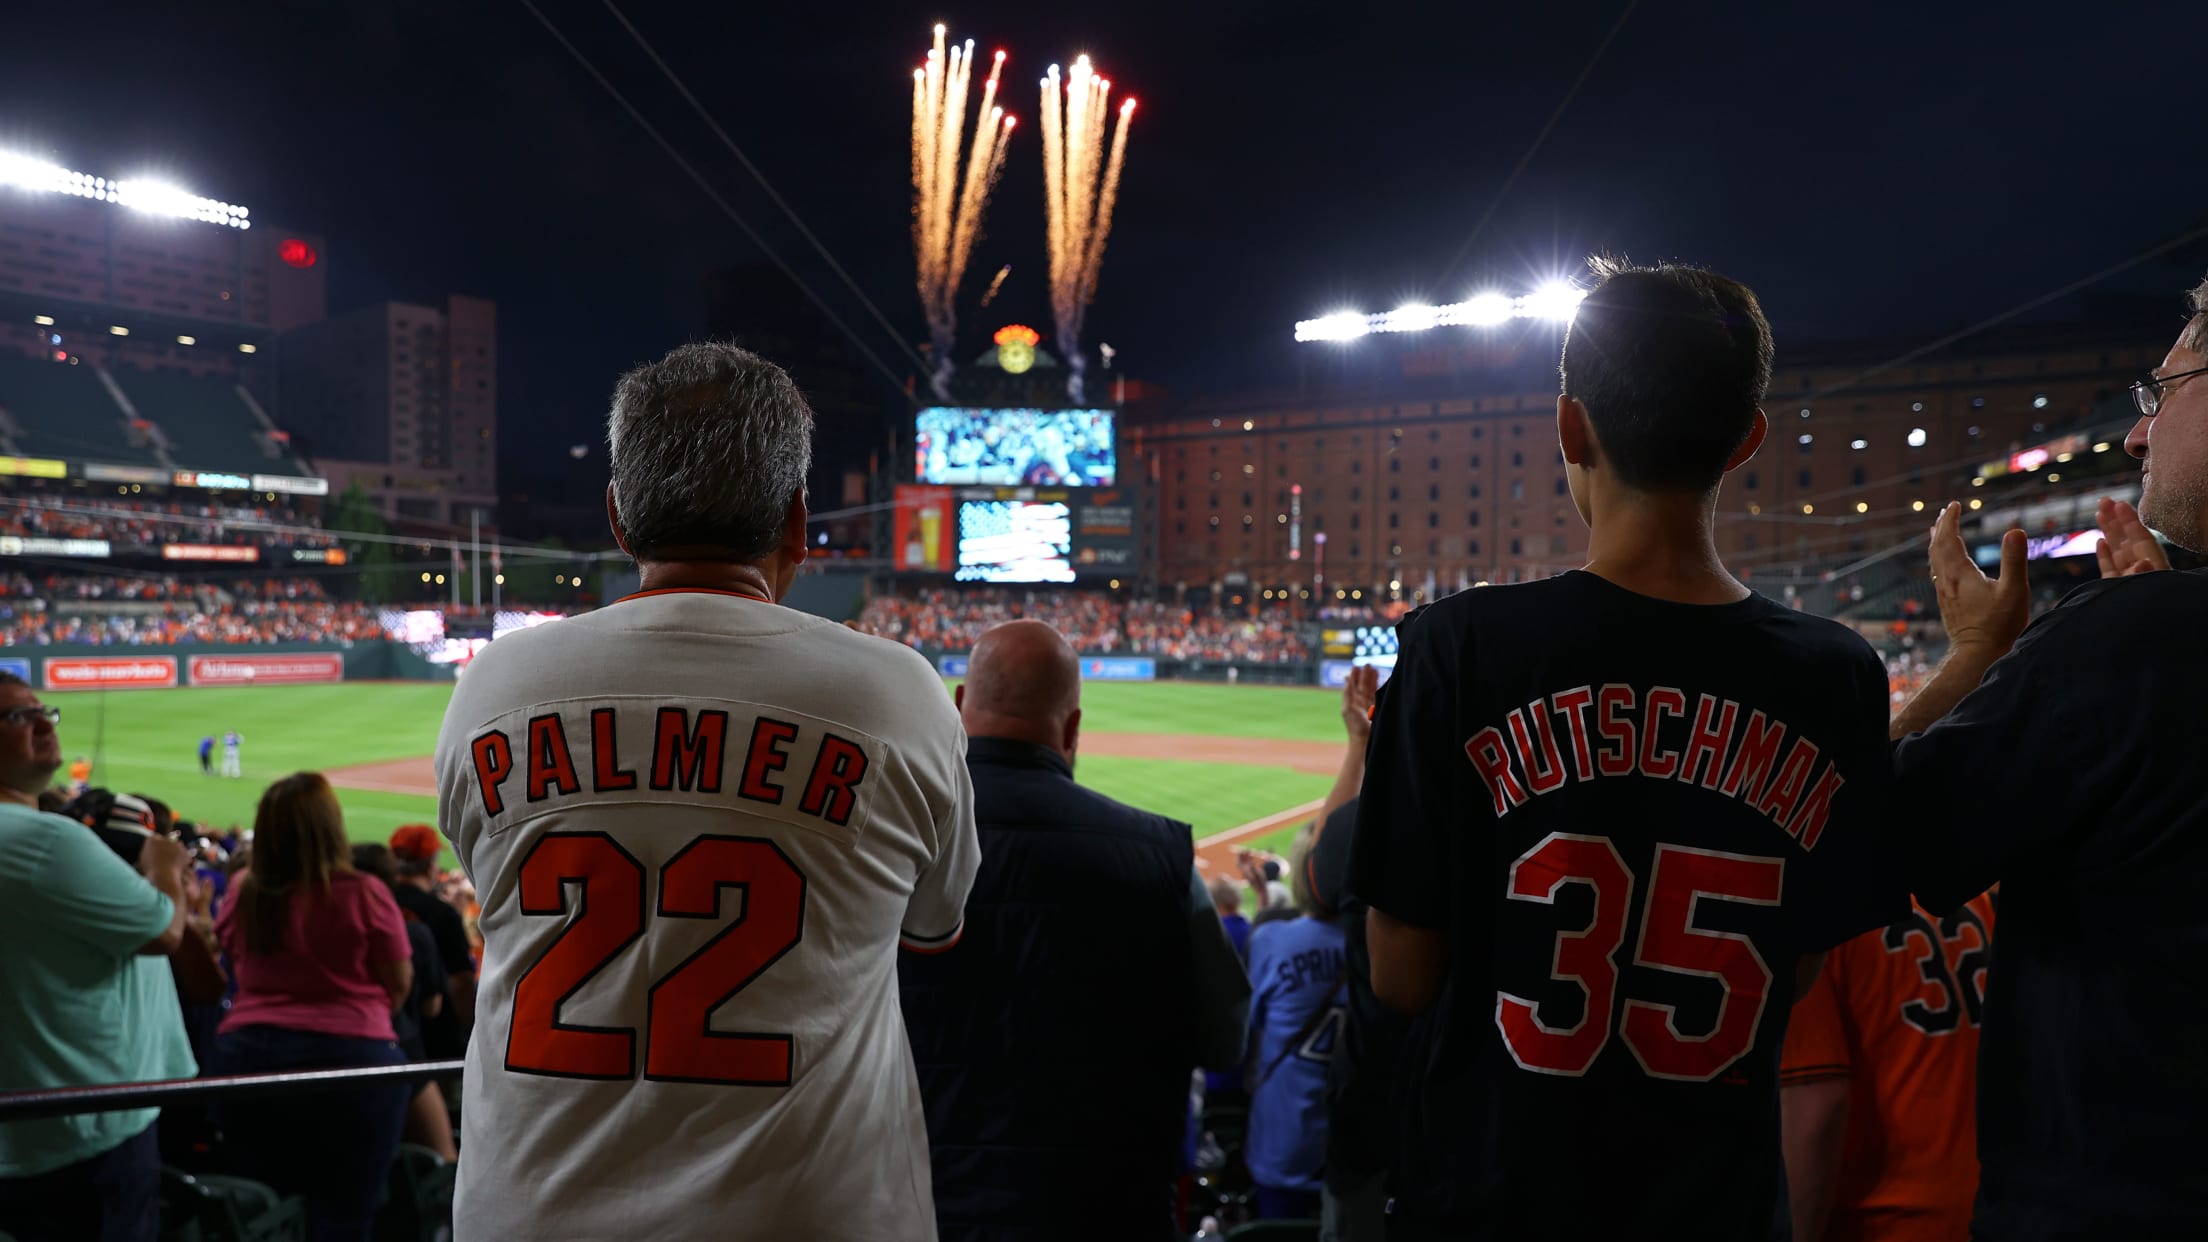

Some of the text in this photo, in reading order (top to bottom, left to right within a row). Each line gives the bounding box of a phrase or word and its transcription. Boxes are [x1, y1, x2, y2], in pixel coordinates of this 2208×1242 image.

[471, 707, 869, 826] PALMER
[1464, 683, 1845, 852] RUTSCHMAN
[504, 831, 806, 1087] 22
[1494, 831, 1786, 1083] 35
[1882, 903, 1991, 1037] 32
